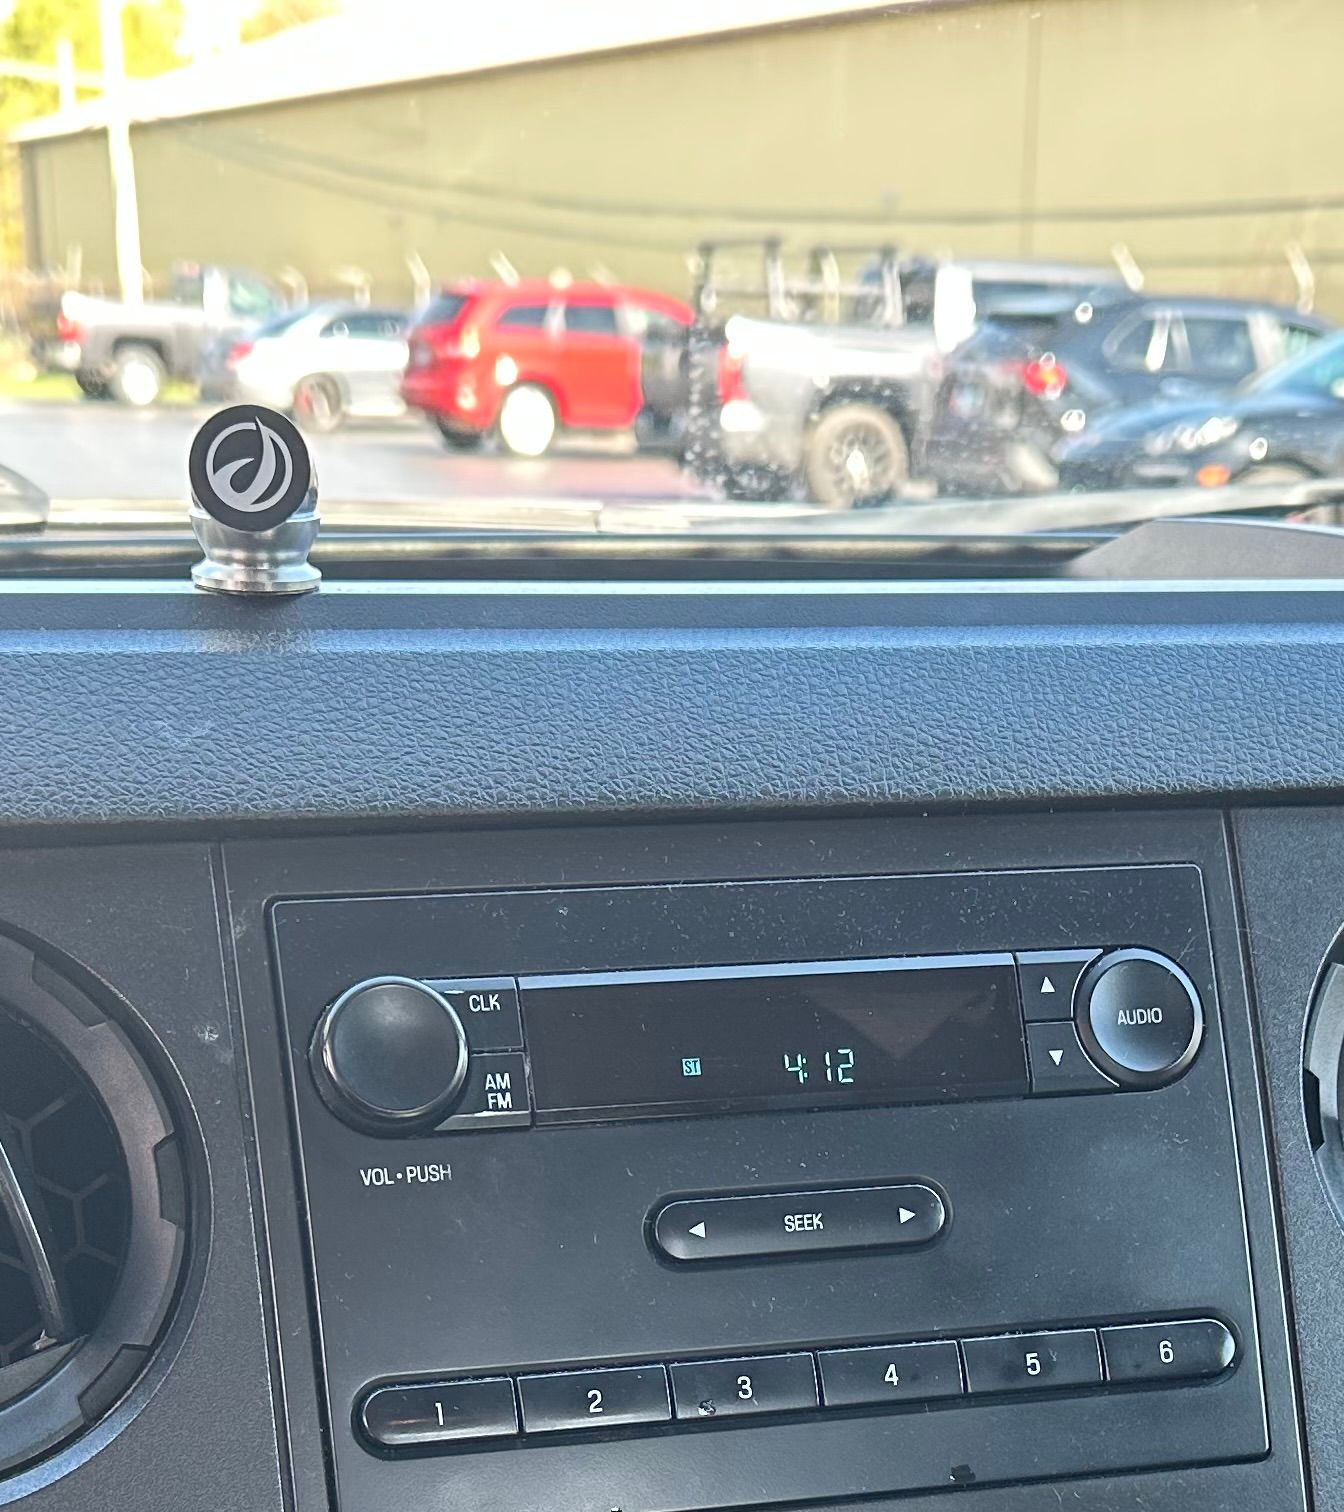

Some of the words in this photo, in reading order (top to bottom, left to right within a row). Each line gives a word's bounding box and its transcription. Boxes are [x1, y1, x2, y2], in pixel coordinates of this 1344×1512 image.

[468, 993, 502, 1013] CLK
[1117, 1004, 1163, 1026] AUDIO
[682, 1058, 702, 1077] ST
[783, 1048, 855, 1085] 4:12
[484, 1072, 512, 1091] AM
[486, 1091, 514, 1110] FM
[783, 1212, 825, 1233] SEEK
[1159, 1340, 1174, 1364] 6
[884, 1363, 899, 1387] 4
[1025, 1352, 1042, 1377] 5
[736, 1375, 753, 1401] 3
[587, 1389, 604, 1414] 2
[432, 1402, 446, 1428] 1
